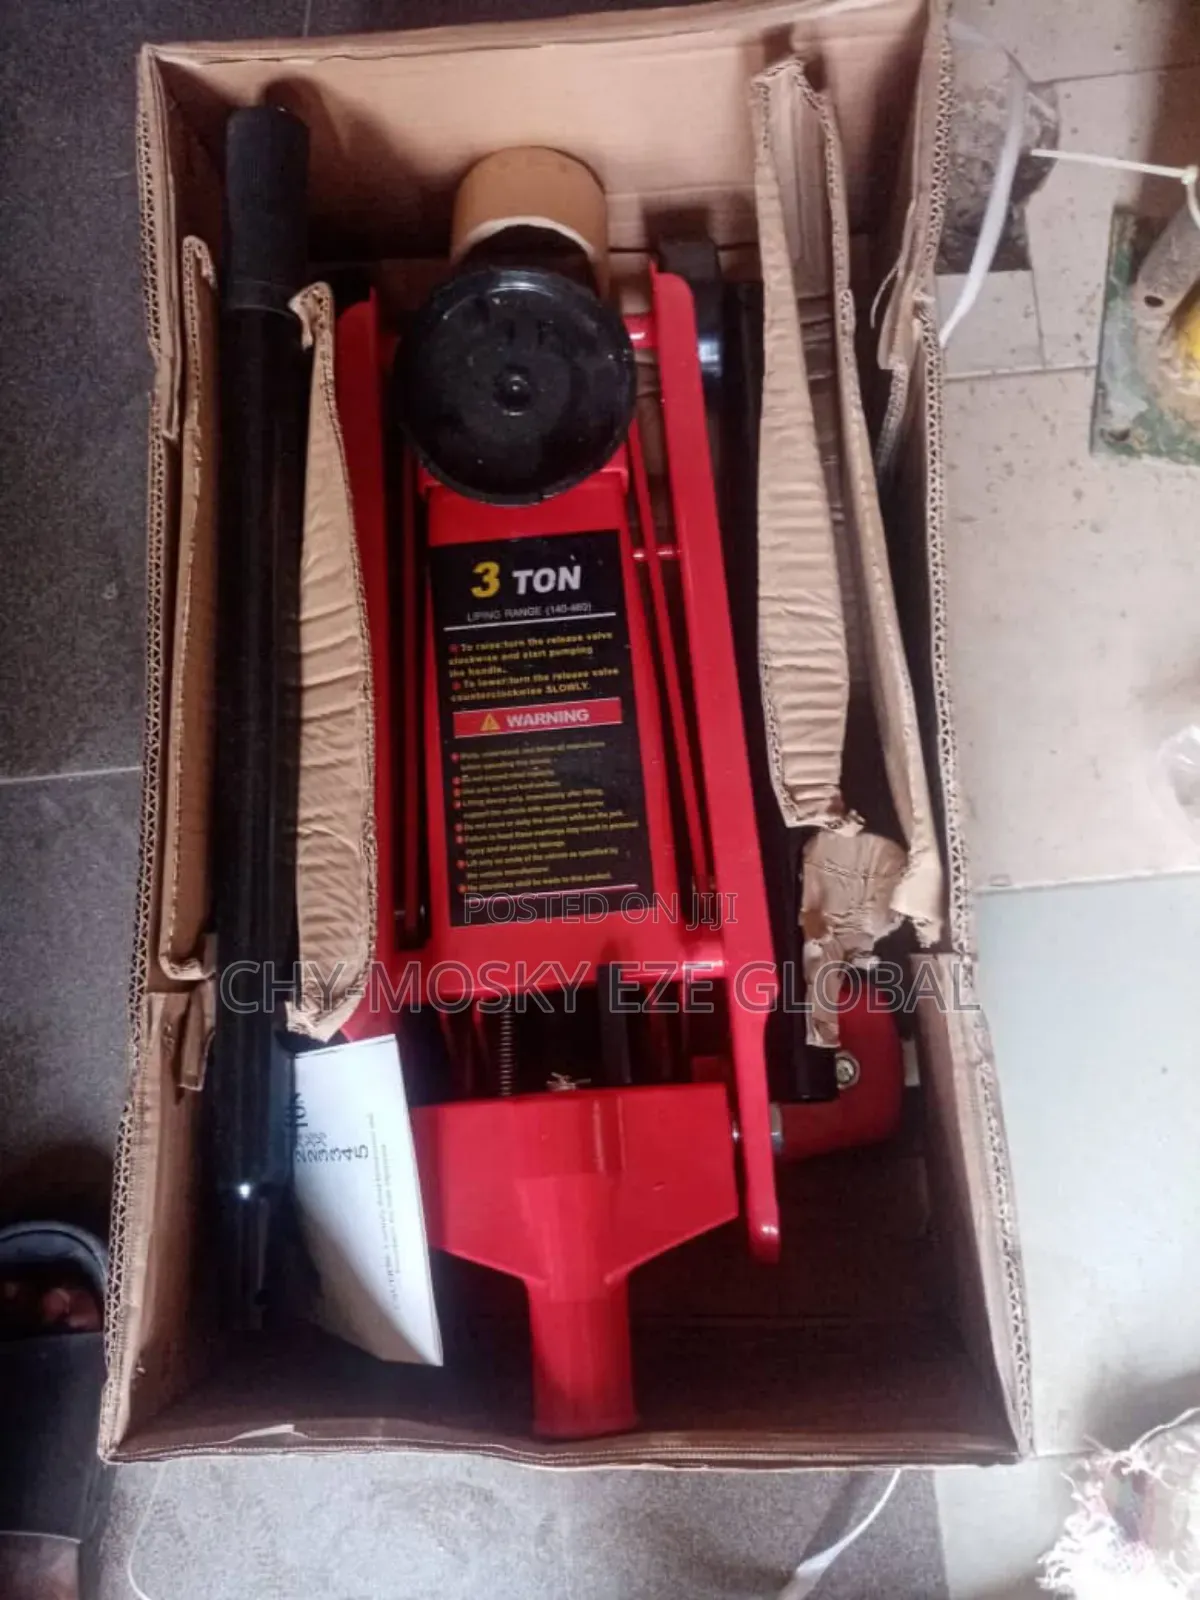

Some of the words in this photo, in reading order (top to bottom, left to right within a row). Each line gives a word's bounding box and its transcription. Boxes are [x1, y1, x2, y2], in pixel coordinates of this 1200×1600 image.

[471, 561, 500, 598] 3
[512, 565, 581, 595] TON
[504, 605, 541, 618] RANGE
[527, 637, 544, 646] the
[533, 674, 549, 682] the
[506, 709, 590, 728] WARNING
